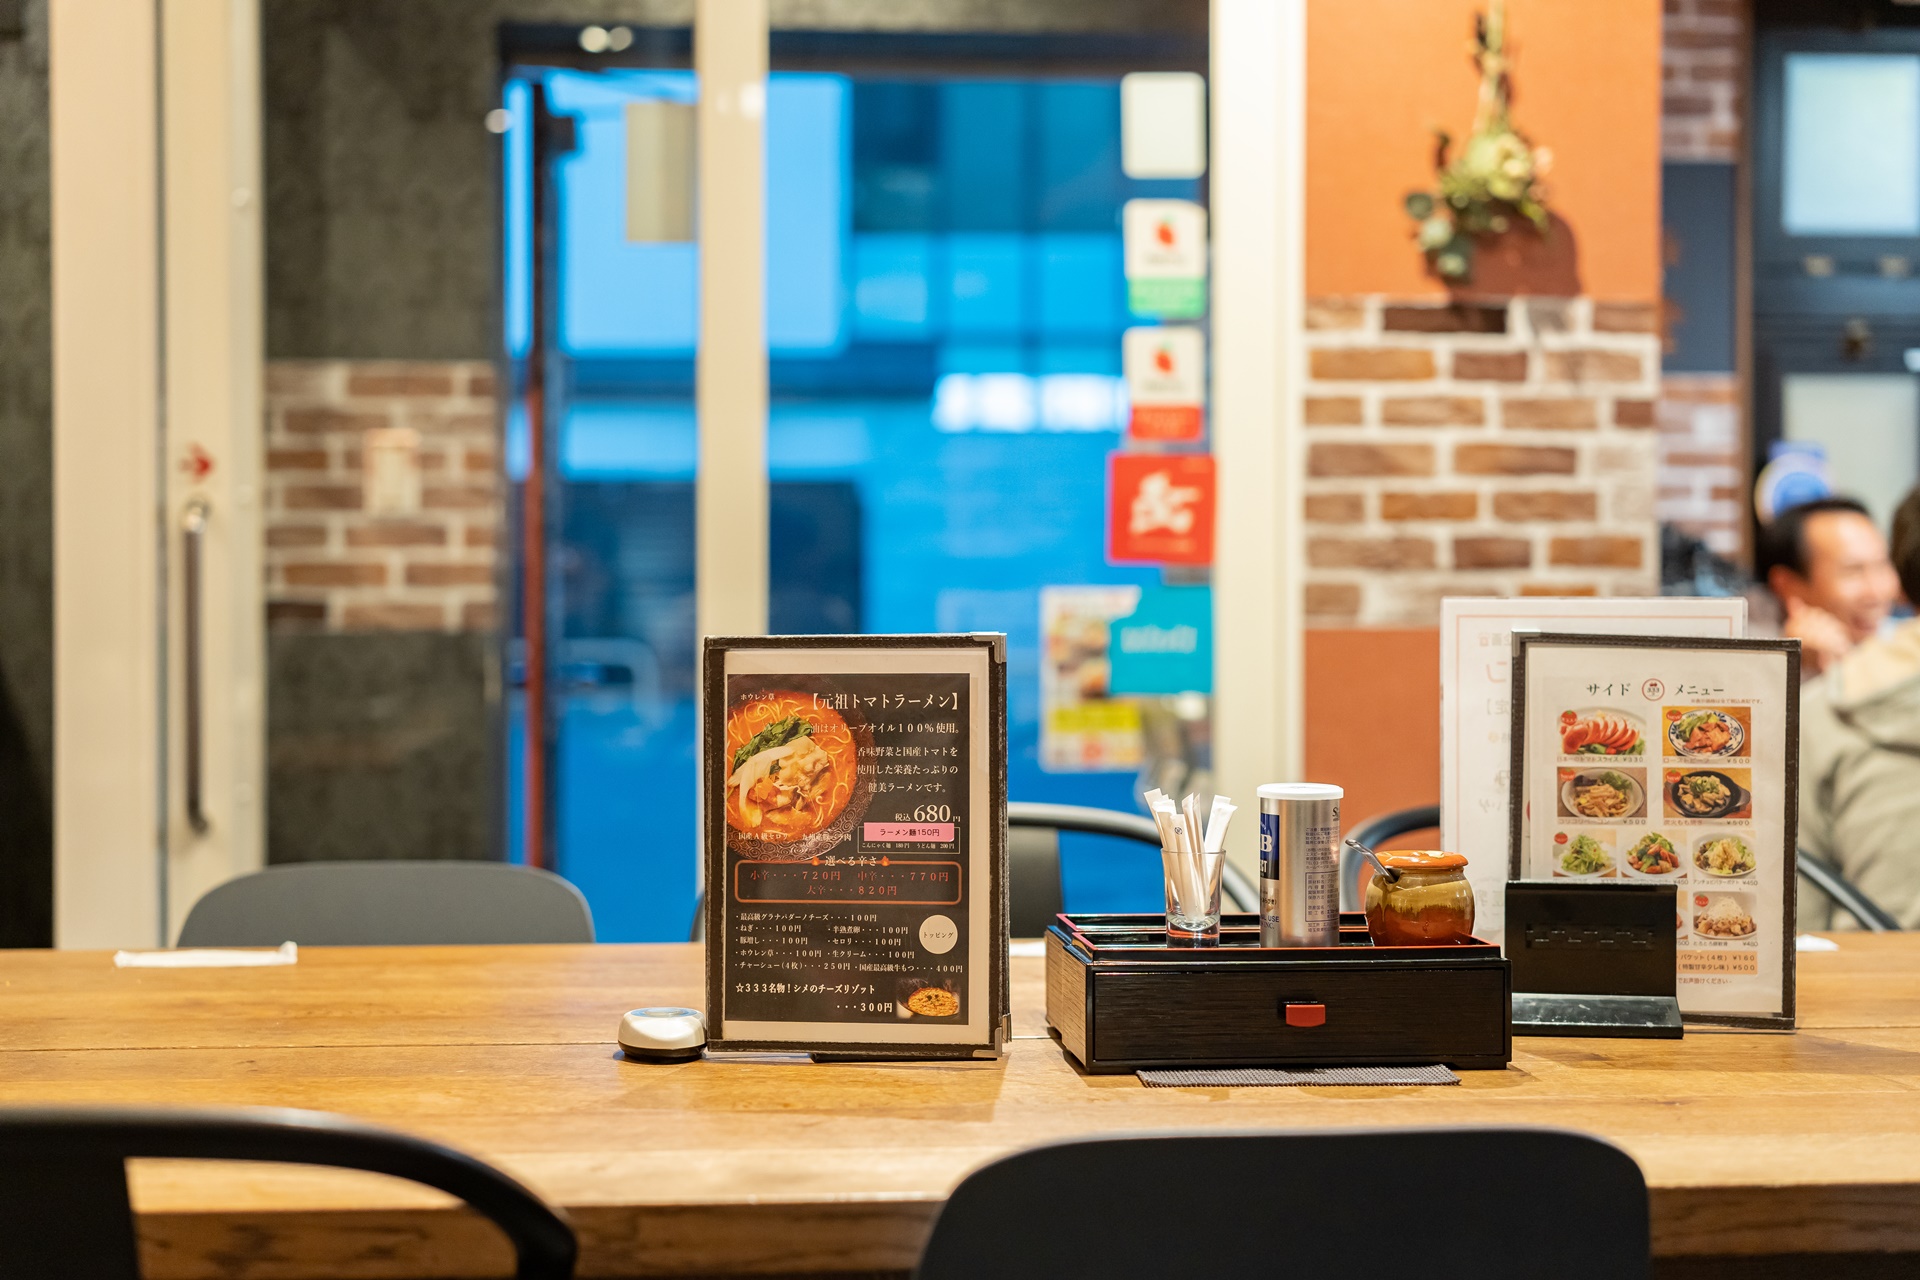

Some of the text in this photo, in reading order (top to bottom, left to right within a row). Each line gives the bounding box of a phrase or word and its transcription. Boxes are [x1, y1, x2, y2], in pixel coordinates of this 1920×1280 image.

[1586, 683, 1631, 697] サイド
[1674, 683, 1725, 697] メニュー
[740, 693, 775, 702] ホウレン草
[809, 692, 960, 712] 【元祖トマトラーメン】
[857, 746, 958, 758] 香味野菜と国産トマトを
[857, 764, 958, 776] 使用した栄養たっぷりの
[868, 781, 947, 794] 健美ラーメンです。
[879, 827, 940, 838] ラーメン麺150円
[824, 855, 878, 867] 選べる辛さ
[922, 930, 955, 940] トッピング
